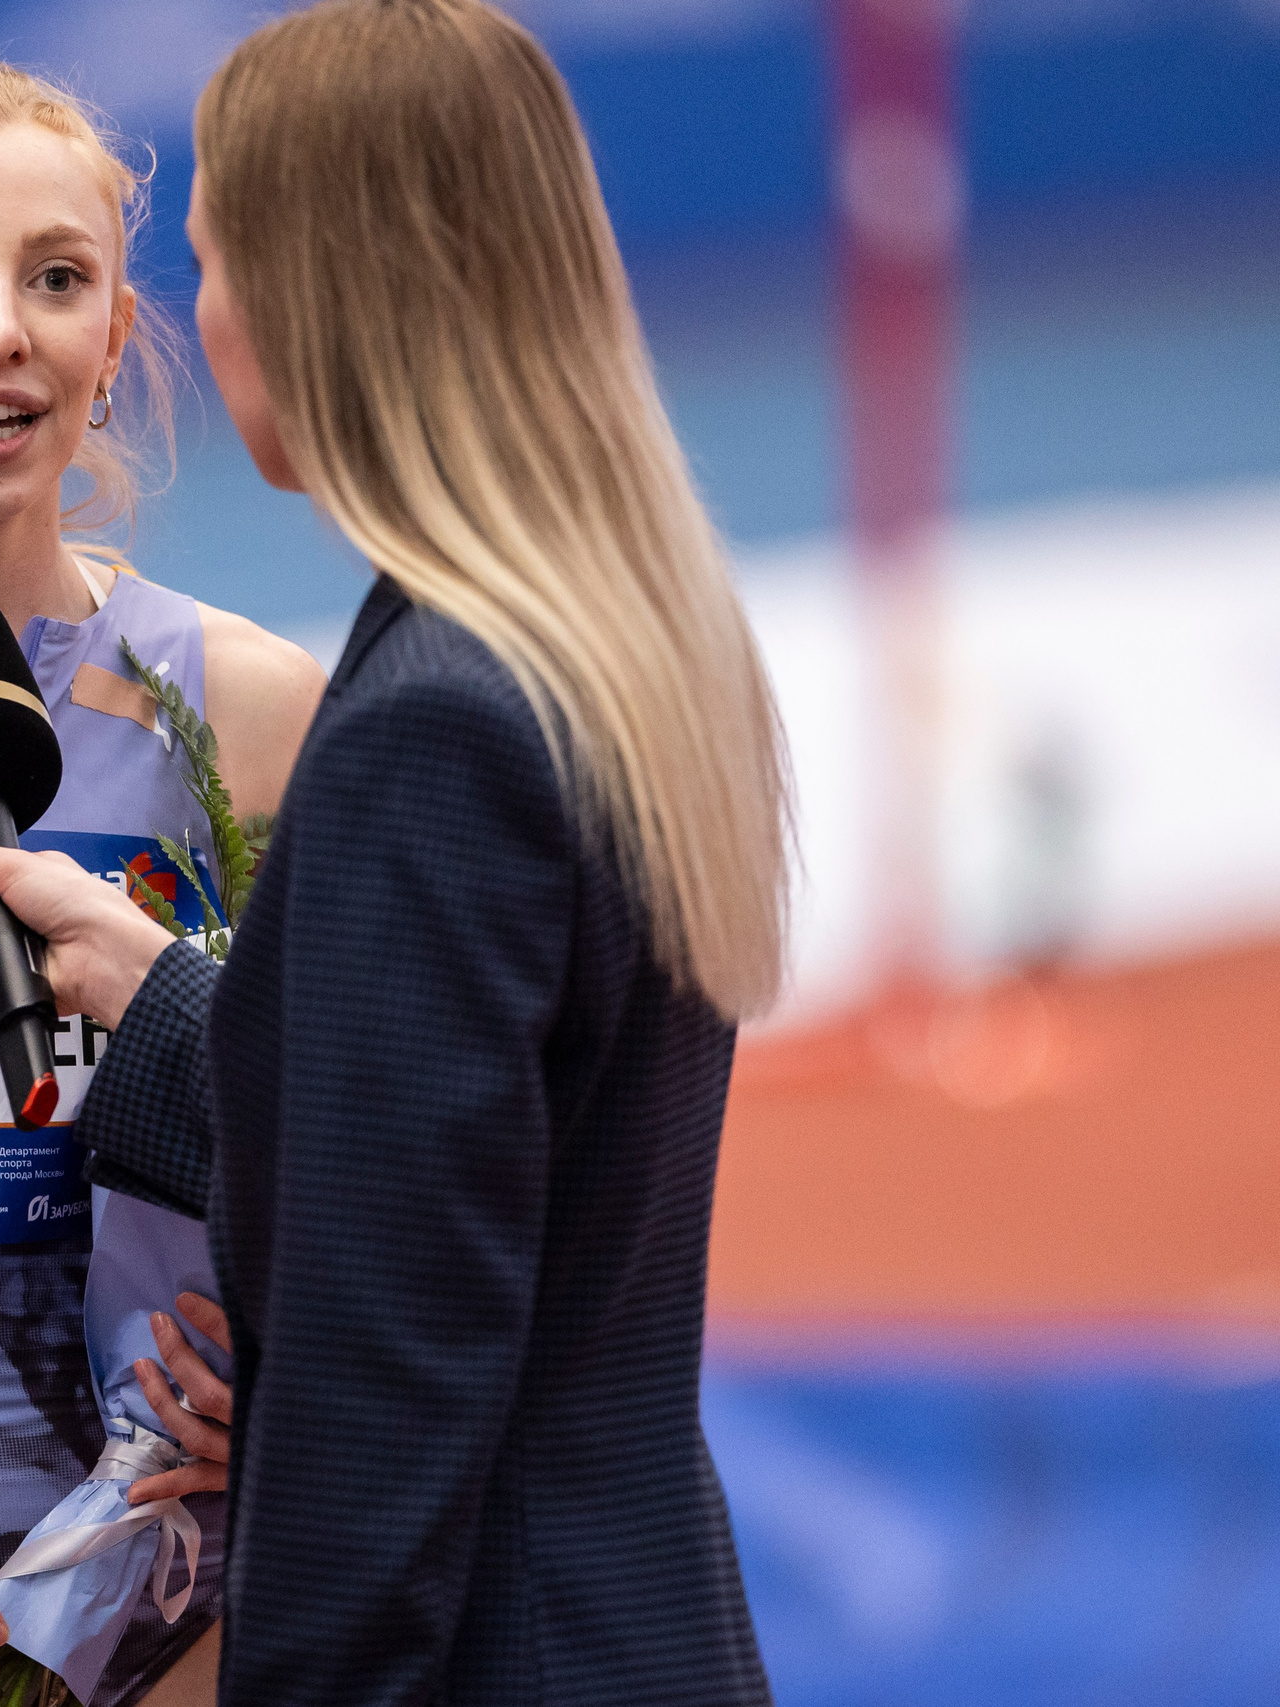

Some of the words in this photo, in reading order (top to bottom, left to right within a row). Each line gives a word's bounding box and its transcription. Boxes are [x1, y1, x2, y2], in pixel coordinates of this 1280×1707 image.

[0, 1159, 32, 1169] спорта
[0, 1171, 33, 1182] города
[34, 1170, 65, 1180] Москвы
